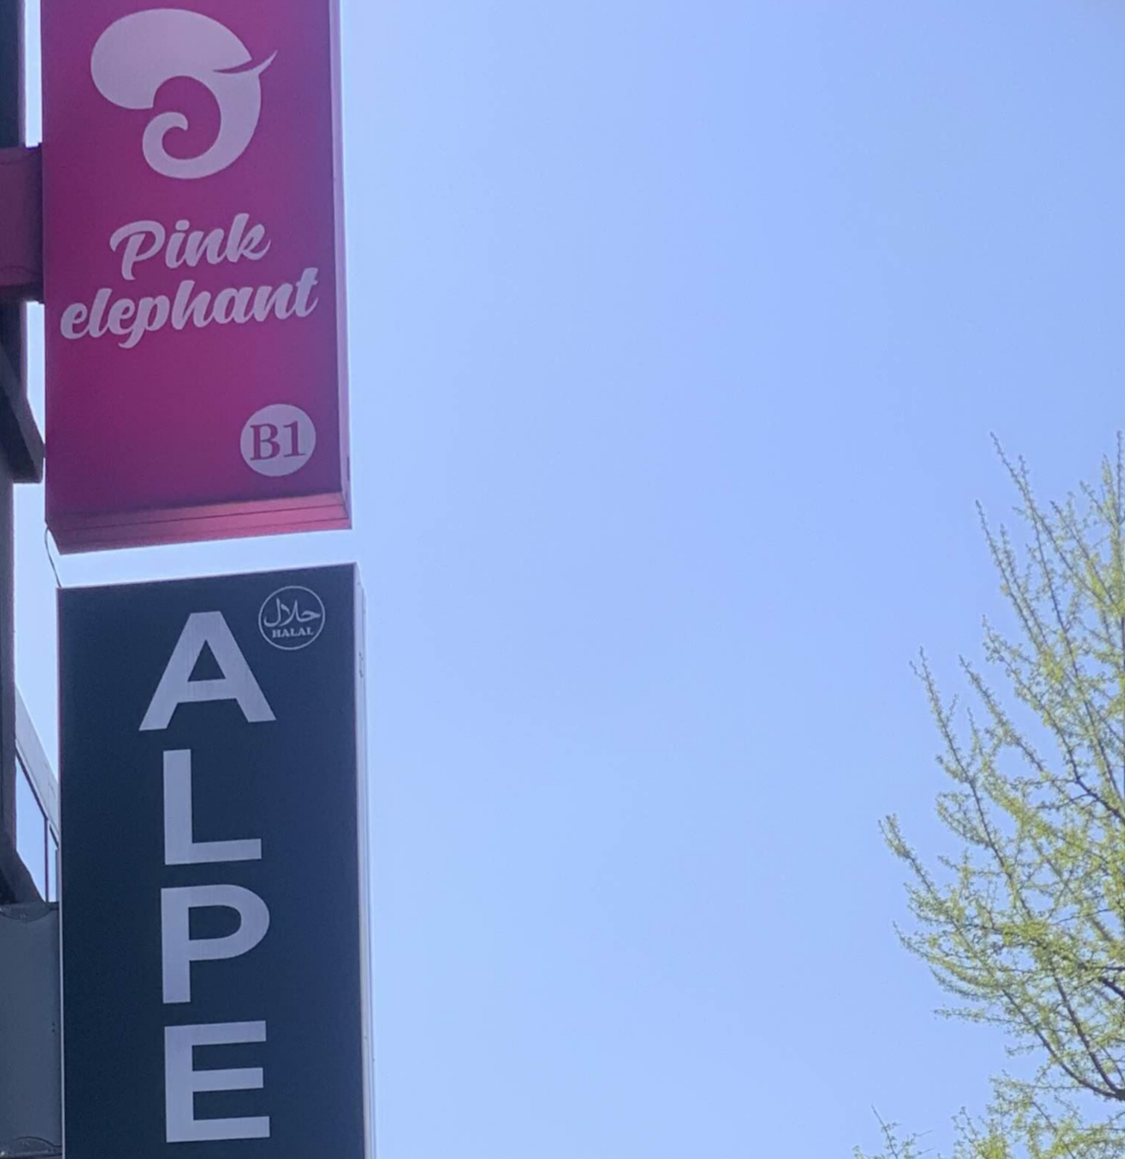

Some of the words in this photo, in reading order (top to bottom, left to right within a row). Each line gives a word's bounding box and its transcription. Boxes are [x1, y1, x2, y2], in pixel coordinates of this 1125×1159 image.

[109, 213, 272, 281] Pink
[60, 267, 319, 349] elephant
[249, 420, 307, 461] B1
[272, 627, 314, 638] HALAL
